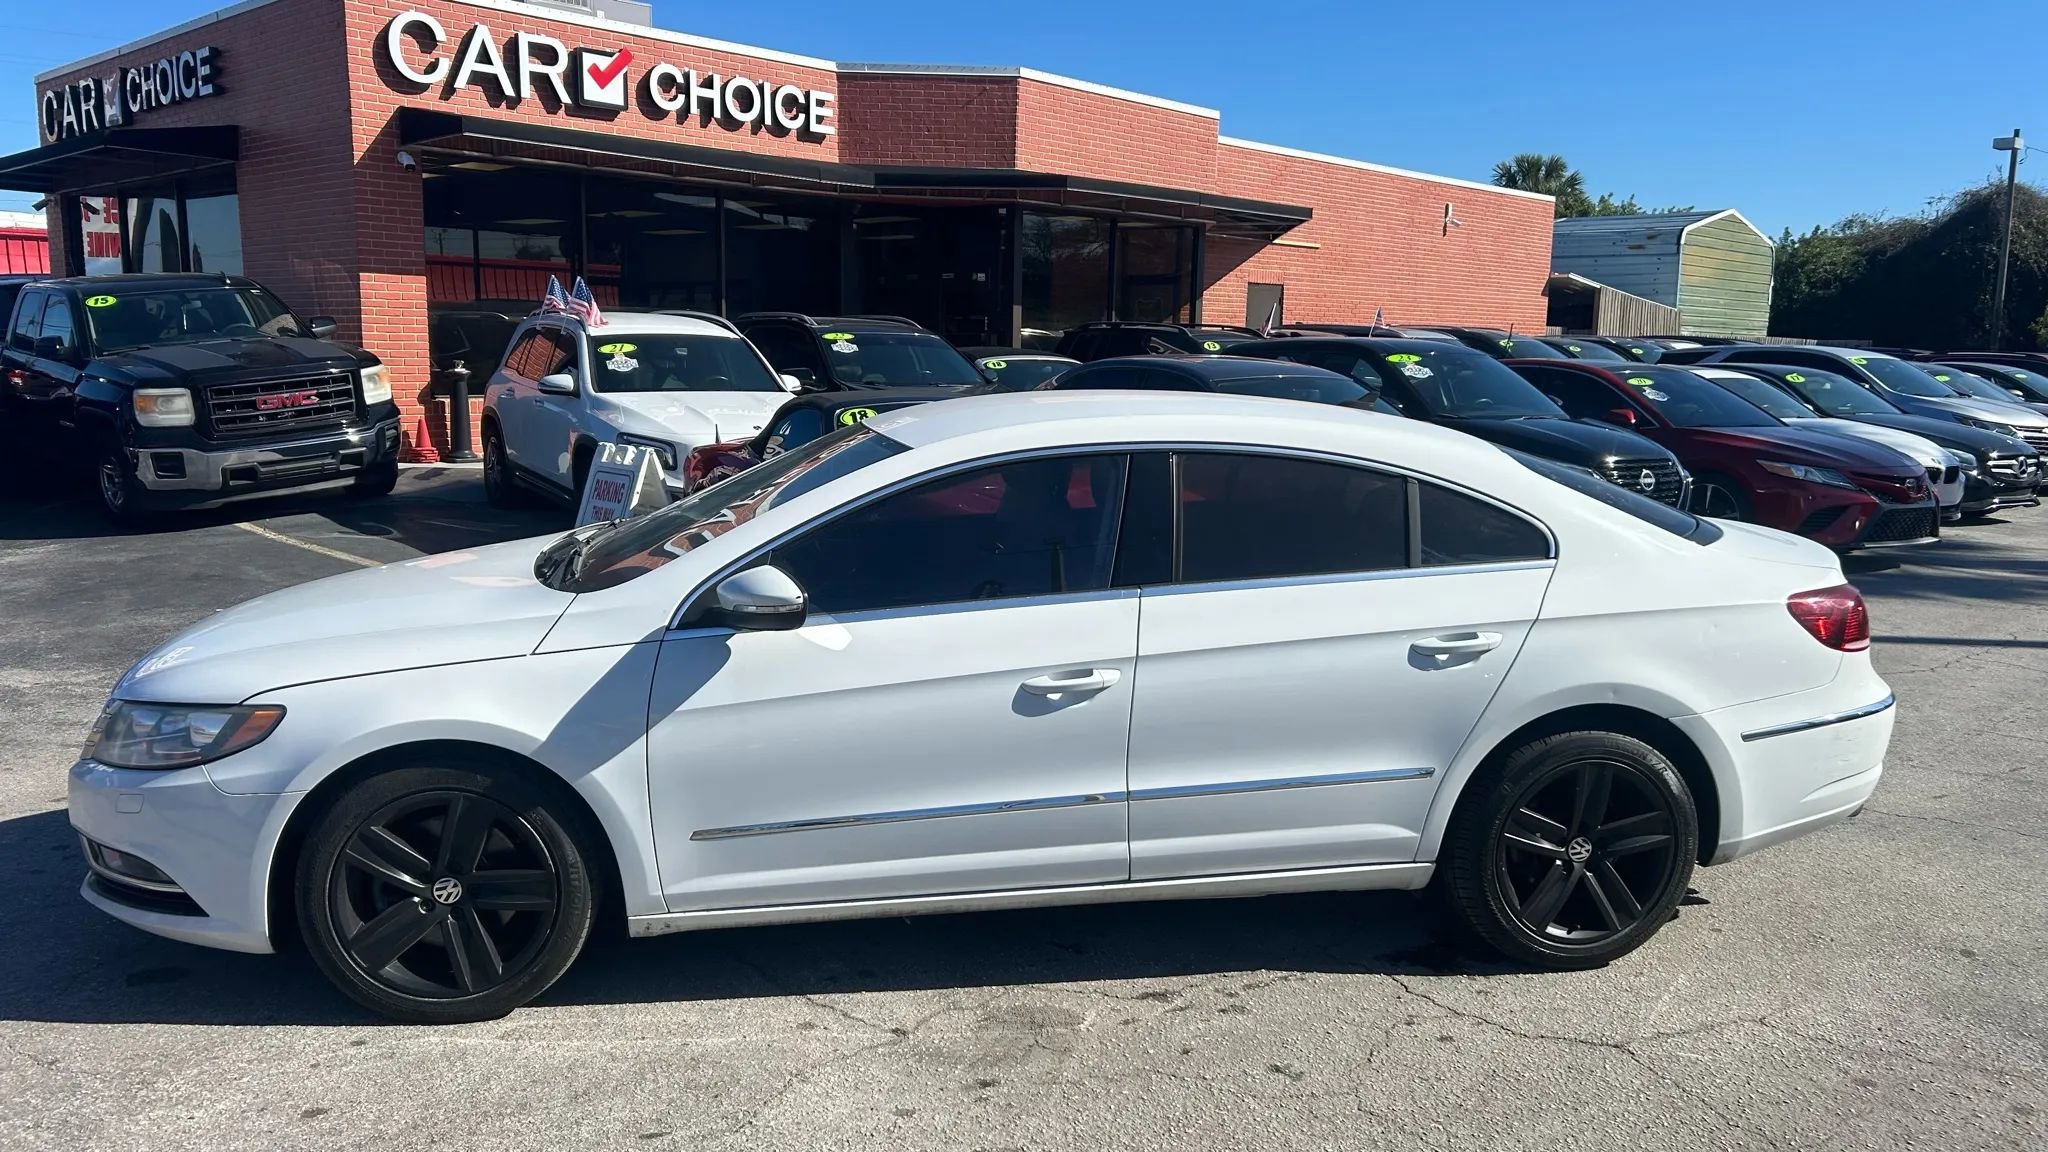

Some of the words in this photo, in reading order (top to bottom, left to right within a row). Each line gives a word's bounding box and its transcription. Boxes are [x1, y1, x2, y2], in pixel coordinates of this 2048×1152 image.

[389, 10, 572, 104] CAR
[650, 62, 836, 135] CHOICE
[43, 78, 99, 142] CAR
[126, 46, 213, 112] CHOICE
[93, 296, 109, 306] 15
[609, 343, 625, 353] 21
[255, 389, 320, 410] GMC
[848, 409, 870, 424] 18
[591, 479, 626, 504] PARKING
